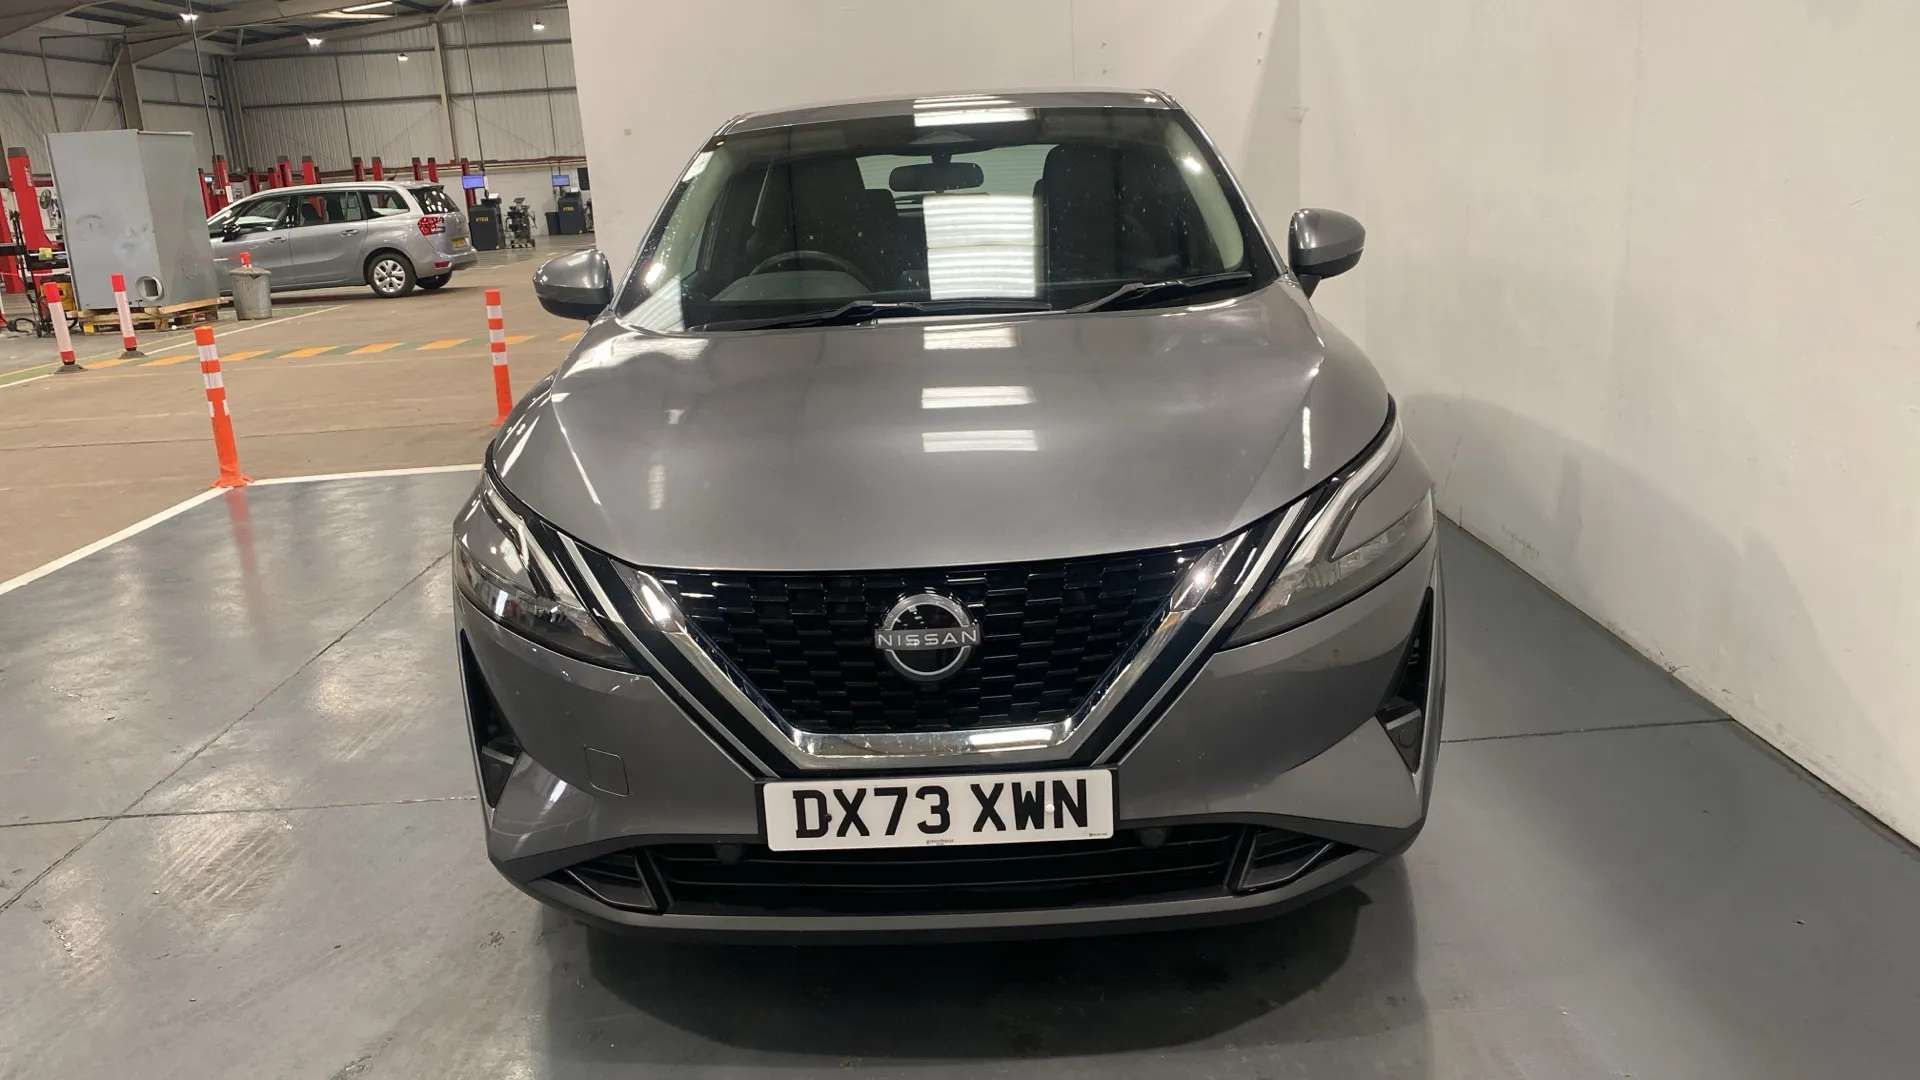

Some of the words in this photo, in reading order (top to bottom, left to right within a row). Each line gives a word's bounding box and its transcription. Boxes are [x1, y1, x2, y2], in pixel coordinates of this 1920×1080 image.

[878, 629, 977, 647] NISSAN
[792, 786, 951, 839] DX73
[970, 779, 1088, 833] XWN
